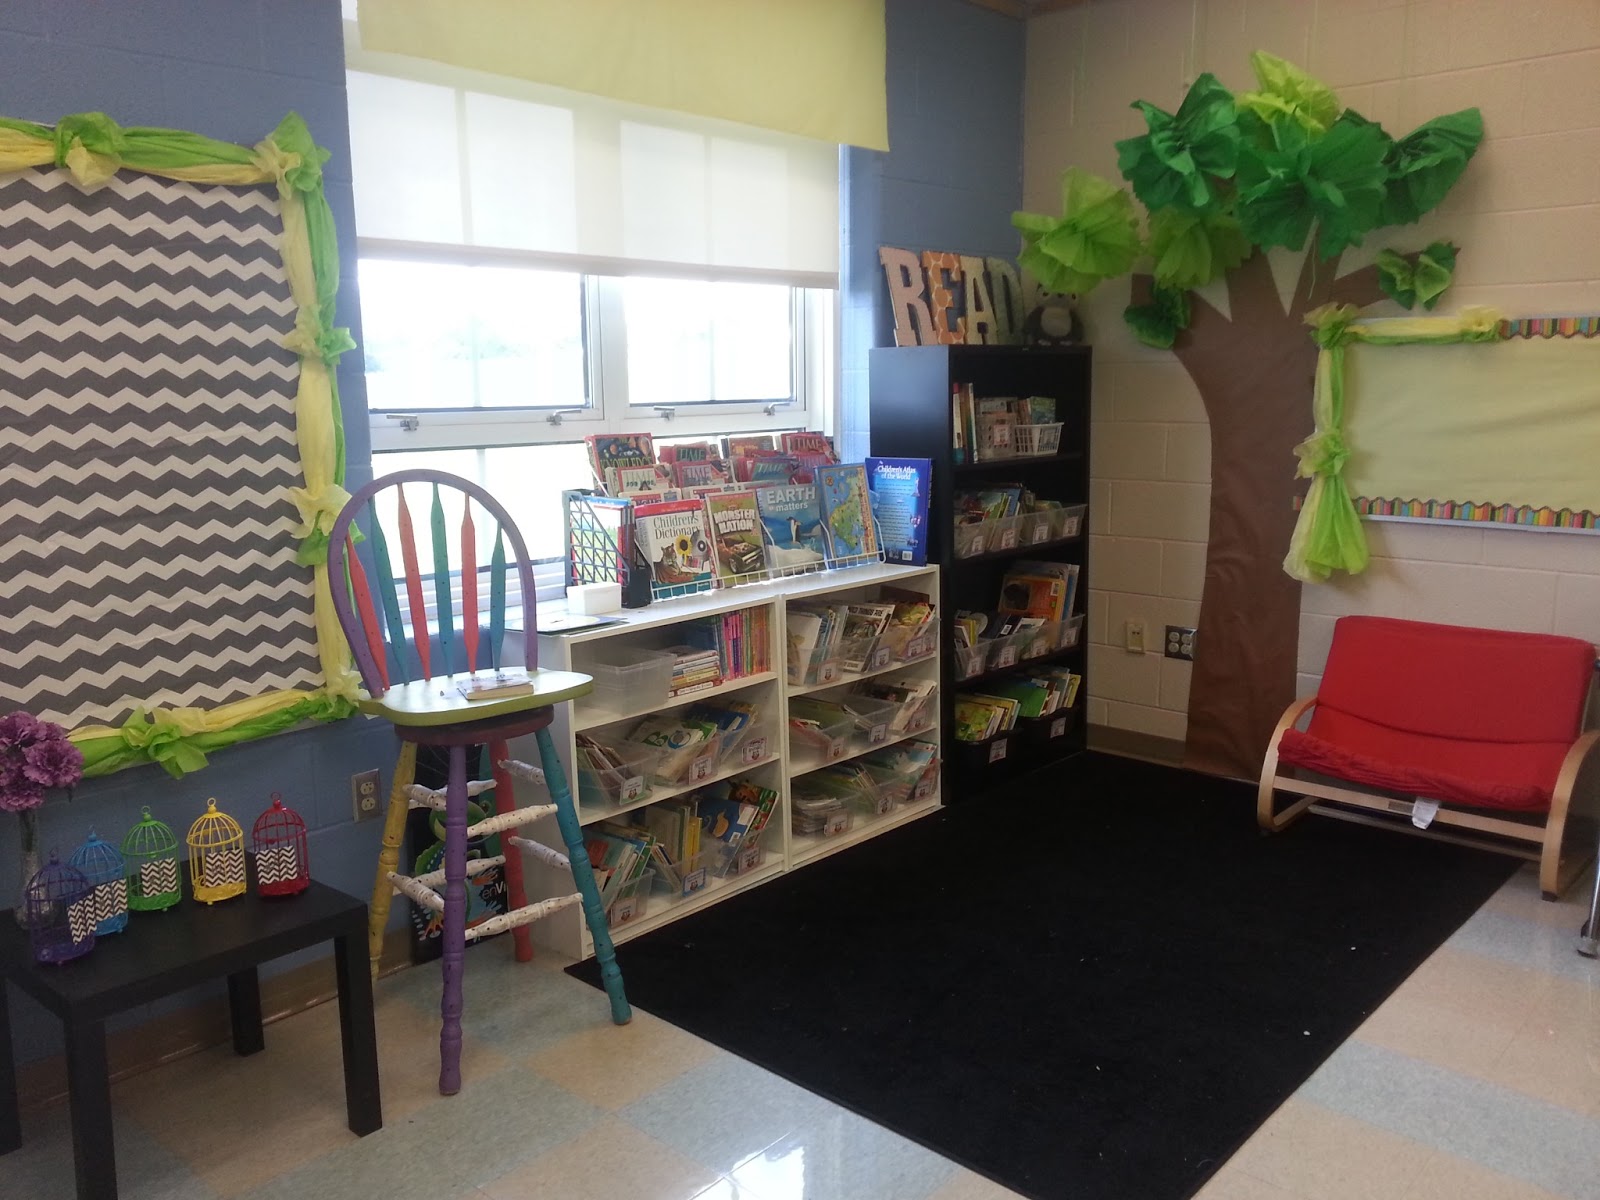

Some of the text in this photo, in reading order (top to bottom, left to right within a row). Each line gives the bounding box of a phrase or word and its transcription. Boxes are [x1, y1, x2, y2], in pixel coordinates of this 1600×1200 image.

[878, 245, 1026, 346] READ
[795, 437, 822, 450] TIME
[678, 448, 705, 460] TIME
[683, 466, 710, 479] TIME
[757, 463, 785, 474] TIME
[903, 465, 916, 474] Atlas
[767, 487, 816, 504] EARTH
[776, 502, 808, 512] matters
[653, 514, 699, 529] Children's
[713, 509, 755, 521] MONSTER
[655, 525, 700, 540] Dictionary
[718, 519, 754, 533] NATION
